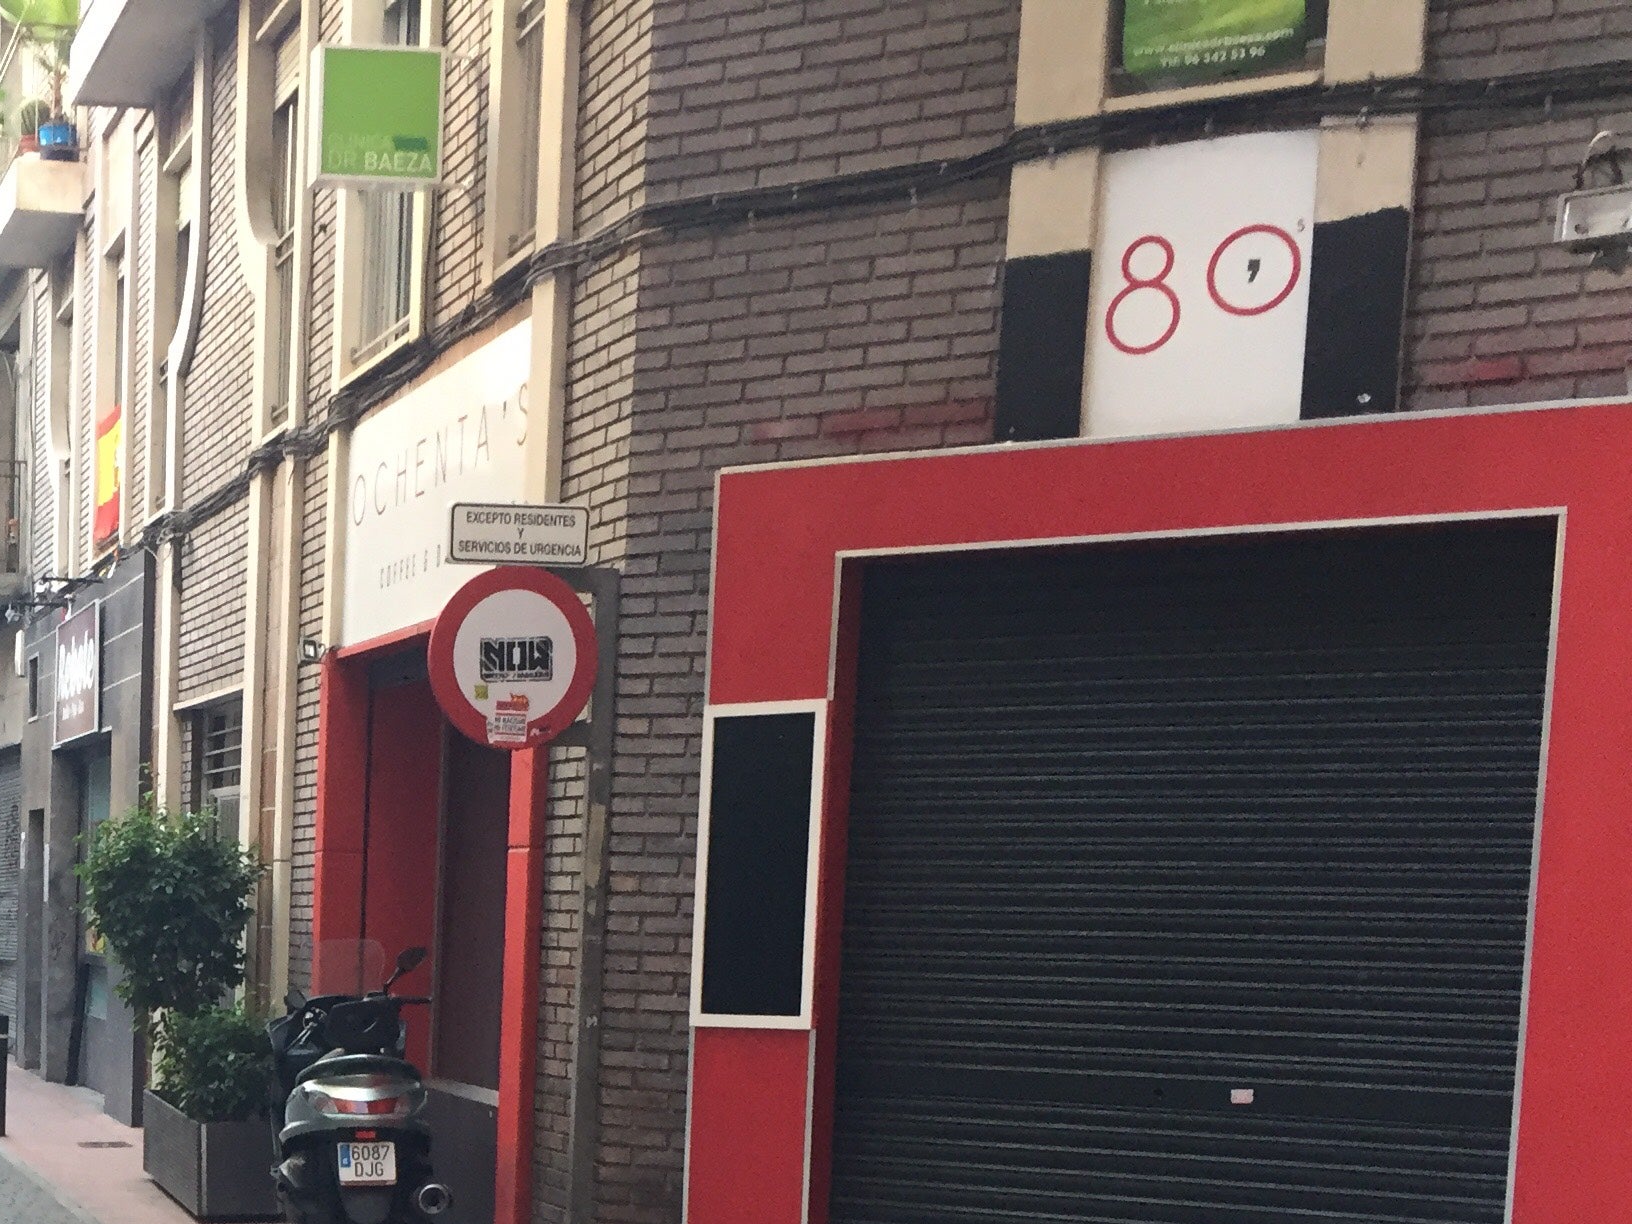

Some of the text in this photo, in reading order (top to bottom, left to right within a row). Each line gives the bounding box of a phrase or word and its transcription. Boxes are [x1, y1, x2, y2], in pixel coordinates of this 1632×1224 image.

[364, 150, 432, 172] BAEZA
[352, 382, 529, 527] OCHENTA'S
[466, 510, 576, 528] EXCEPTO RESIDENTES
[517, 527, 525, 539] Y
[458, 539, 582, 557] SERVICIOS DE URGENCIA
[57, 629, 95, 701] Rebote
[351, 1145, 390, 1161] 6087
[354, 1161, 384, 1178] DJG
